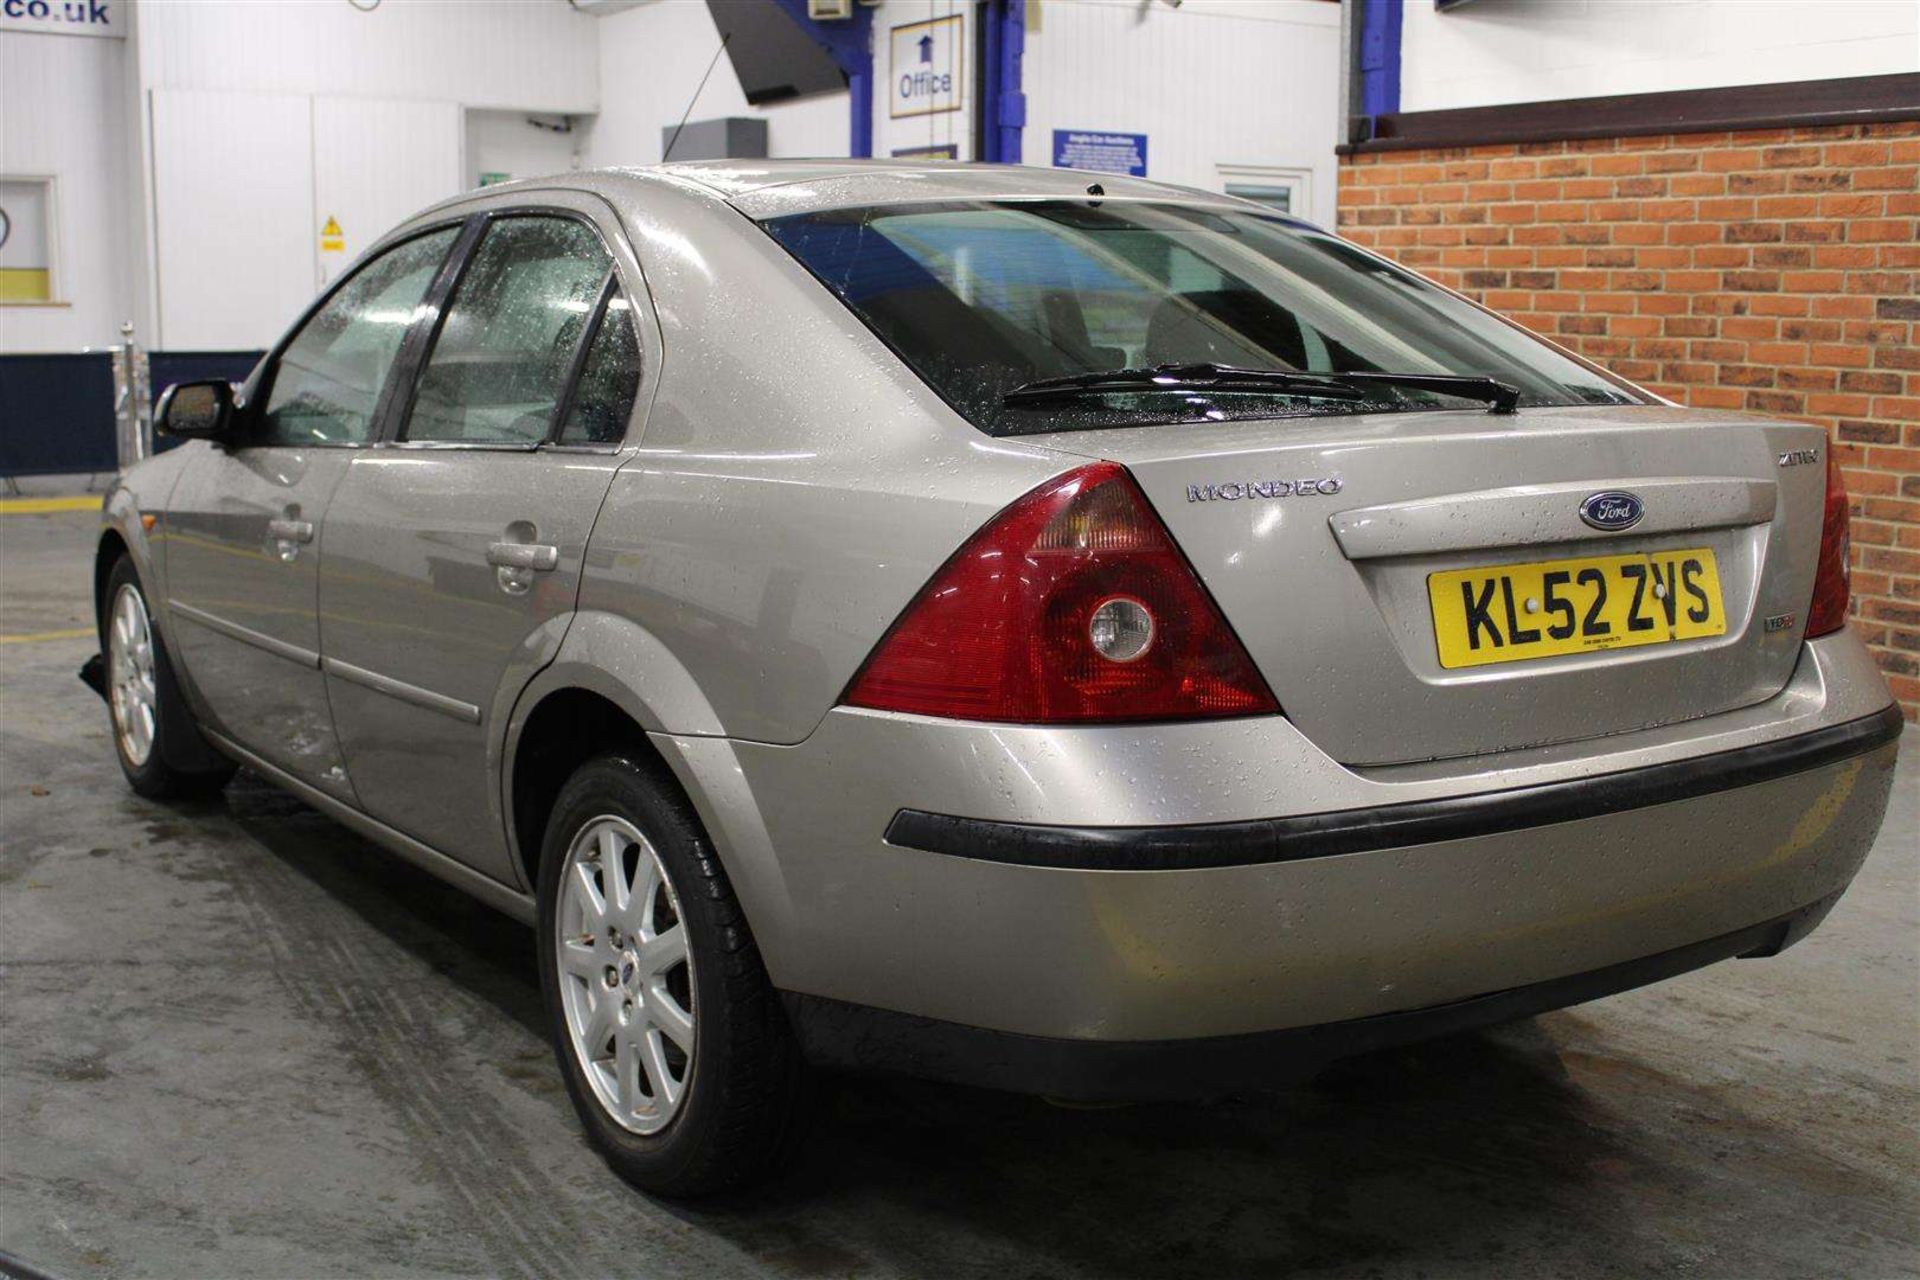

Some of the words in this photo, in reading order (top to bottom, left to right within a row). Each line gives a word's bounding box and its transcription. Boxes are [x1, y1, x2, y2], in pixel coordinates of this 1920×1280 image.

[900, 72, 952, 98] Office
[1186, 475, 1344, 503] MONDEO
[1597, 499, 1631, 520] Ford
[1461, 568, 1611, 650] KL52
[1621, 558, 1710, 631] ZVS
